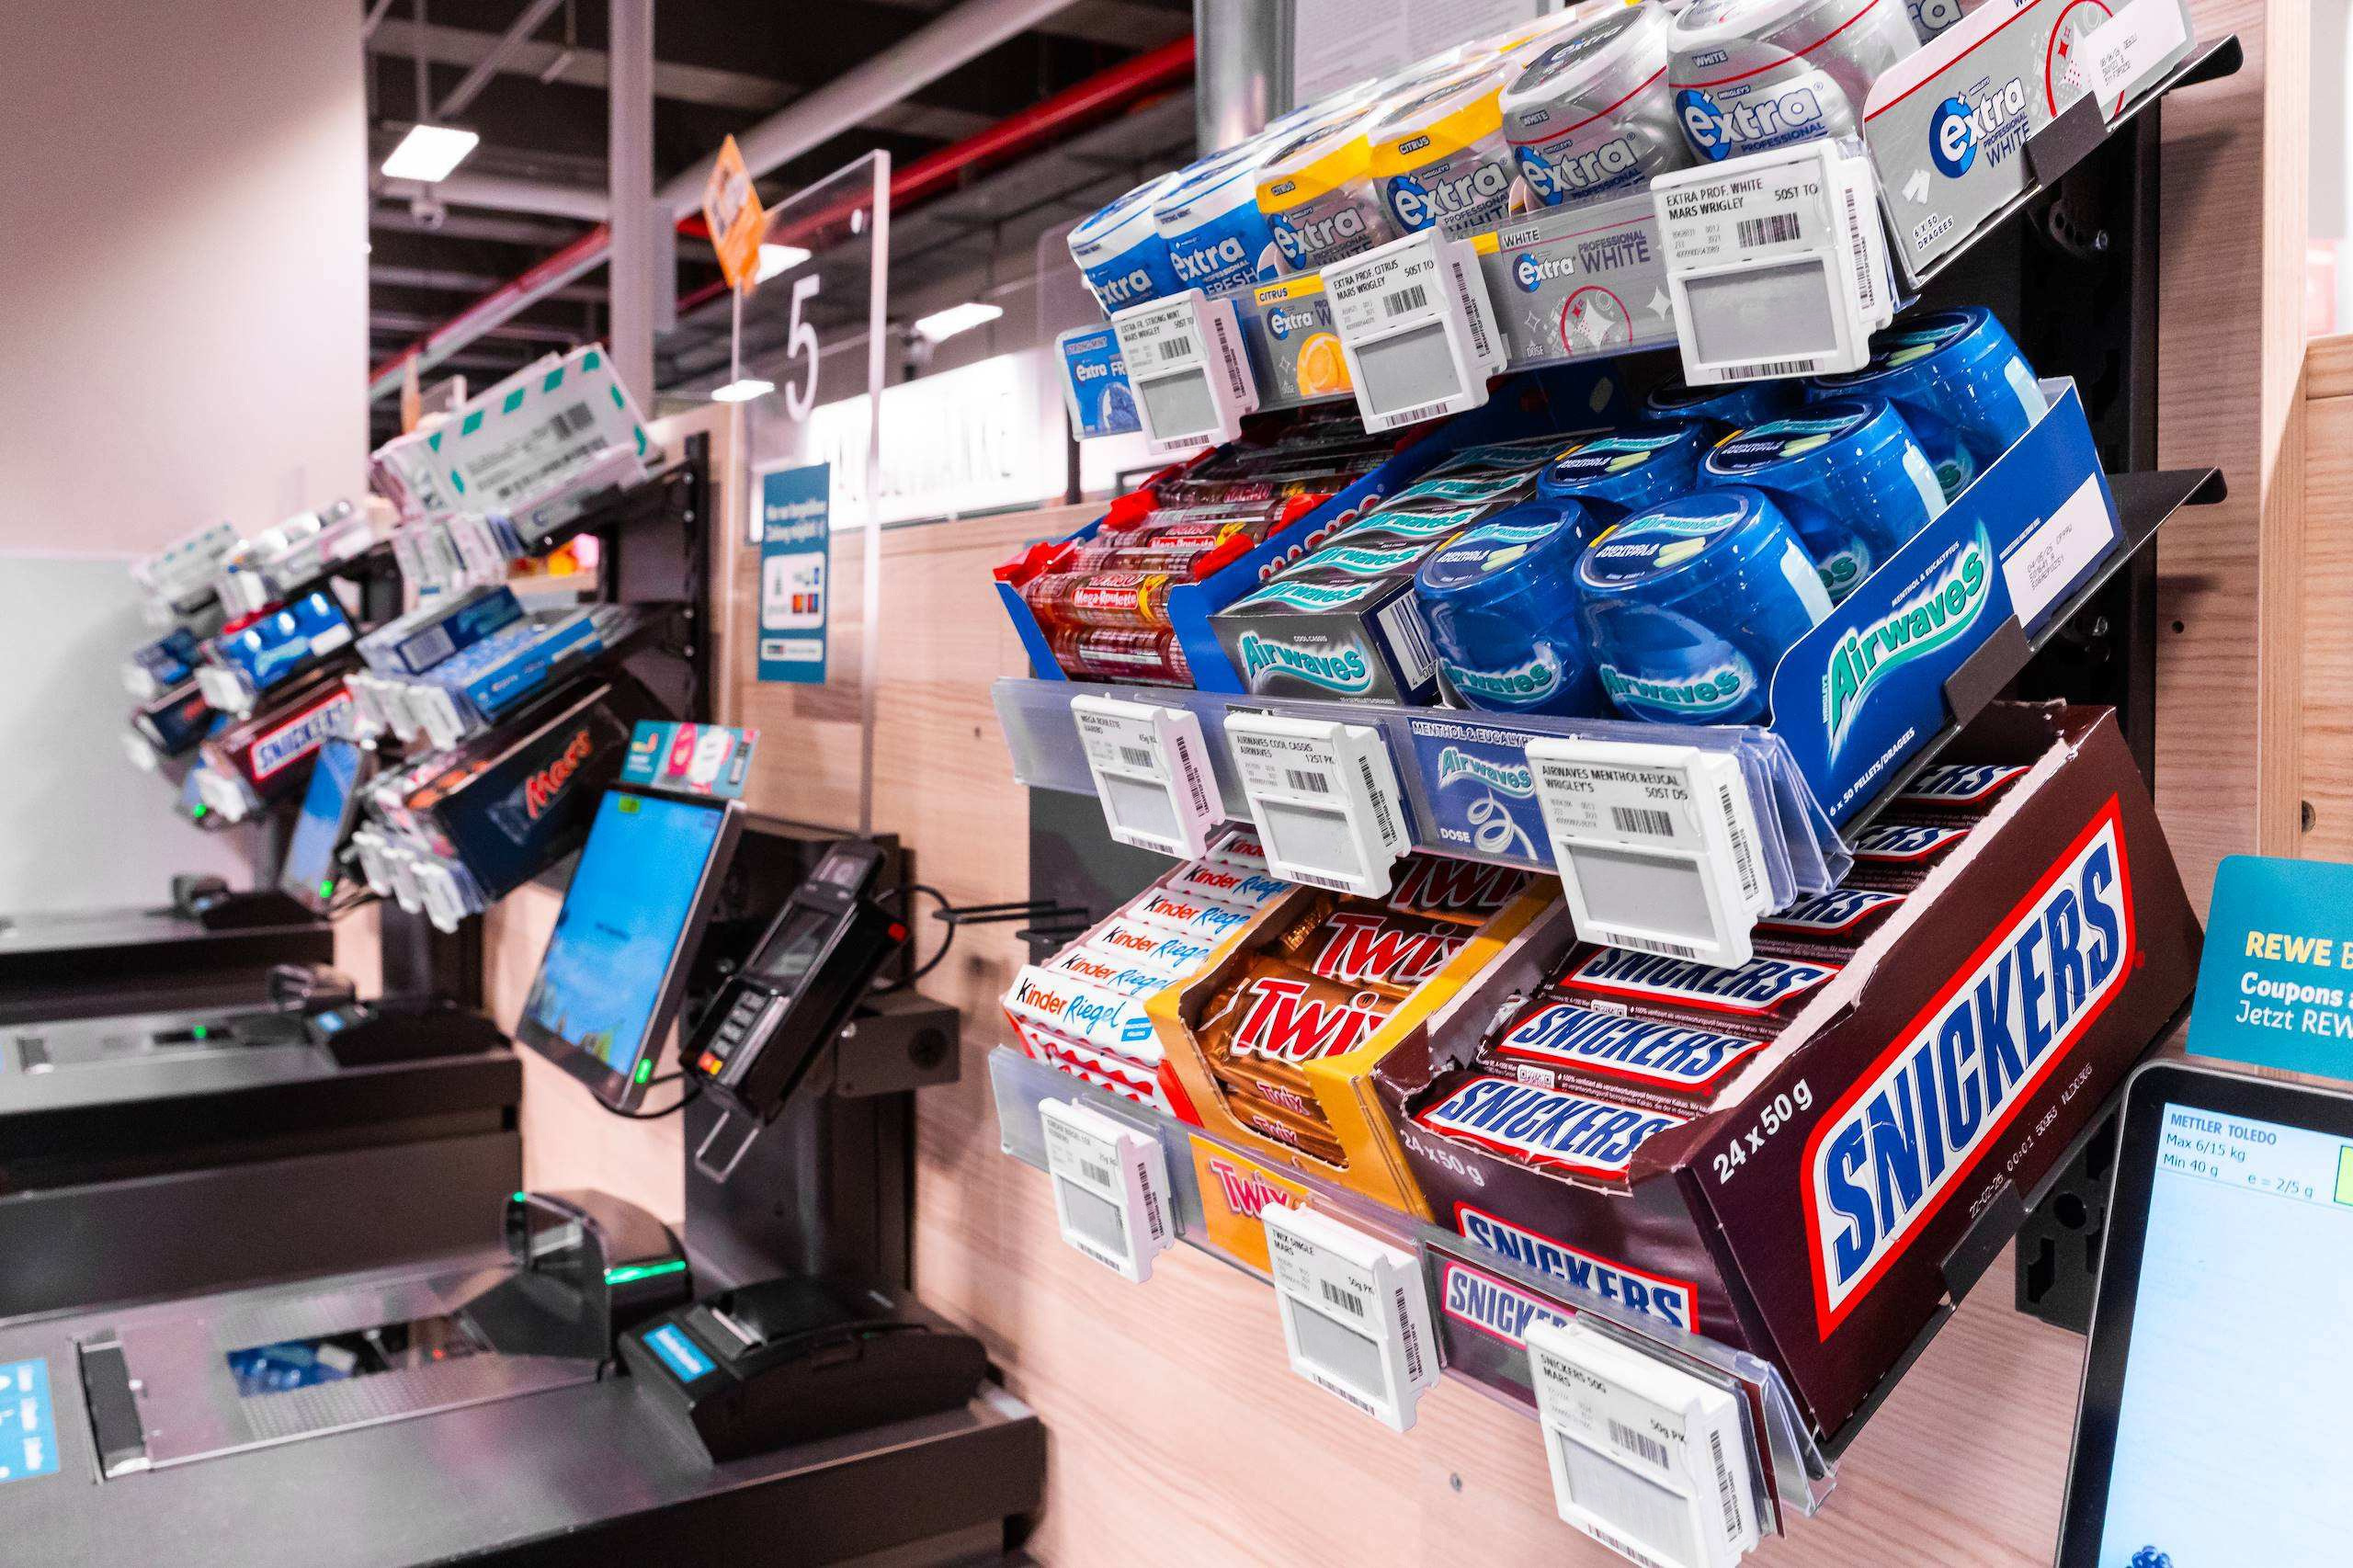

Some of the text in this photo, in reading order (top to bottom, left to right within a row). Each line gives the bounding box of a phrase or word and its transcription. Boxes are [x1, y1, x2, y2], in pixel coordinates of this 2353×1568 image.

[1692, 50, 1728, 68] WHITE
[1520, 109, 1549, 127] WHITE
[1685, 87, 1824, 148] extra
[1939, 77, 2027, 162] extra
[1983, 113, 2028, 149] PROFESSIONAL
[1399, 136, 1430, 154] CITRUS
[1740, 121, 1828, 153] PROFESSIONAL
[1985, 122, 2031, 168] WHITE
[1525, 138, 1639, 198] extra
[1271, 181, 1295, 197] CITRUS
[1393, 162, 1509, 228] extra
[1444, 190, 1507, 223] PROFESSIONA
[1666, 178, 1763, 208] EXTRA PROF. WHITE
[1668, 198, 1745, 221] MARS WRIGLEY
[1274, 207, 1367, 260] extra
[1504, 231, 1540, 248] WHITE
[1579, 229, 1646, 254] PROFESSIONAL
[1170, 236, 1245, 282] extra
[1334, 276, 1356, 290] EXTRA
[1374, 260, 1399, 277] CITRUS
[1518, 256, 1575, 285] extra
[1579, 240, 1651, 275] WHITE
[1258, 287, 1289, 302] CITRUS
[1336, 277, 1386, 301] MARS WRIGLEY
[1271, 309, 1313, 335] extra
[784, 274, 821, 424] 5
[1892, 582, 1920, 608] MENTHOL
[1925, 540, 1960, 579] EUCALYPTUS
[1243, 633, 1370, 683] Airwaves
[1831, 551, 1984, 733] Airwaves
[1599, 664, 1742, 705] Airwaves
[1236, 735, 1269, 747] AIRWAVES
[1240, 746, 1273, 758] AIRWAVES
[526, 730, 593, 820] Mars
[1441, 749, 1531, 789] Airwaves
[1542, 765, 1589, 780] AIRWAVES
[1545, 778, 1595, 794] WRIGLEY'S
[1829, 805, 1836, 816] 6
[1843, 788, 1855, 804] 50
[1854, 727, 1916, 793] PELLETS/DRAGEES
[1440, 827, 1471, 844] DOSE
[1182, 864, 1243, 890] Kinder
[1142, 894, 1251, 936] Kinder Riege
[1102, 925, 1211, 968] Kinder Riege
[2245, 930, 2334, 967] REWE
[1061, 953, 1115, 983] Kinder
[1016, 976, 1067, 1017] Kinder
[1064, 994, 1127, 1036] Riegel
[2240, 971, 2345, 1007] Coupons
[2235, 1000, 2353, 1040] Jetzt REW
[1512, 1006, 1745, 1077] SNICKERS
[1826, 841, 2120, 1287] SNICKERS
[1435, 1081, 1675, 1164] SNICKERS
[1713, 1077, 1813, 1185] 24 x 50 g
[2170, 1112, 2278, 1146] METTLER TOLEDO
[1400, 1129, 1425, 1156] 24
[1437, 1148, 1466, 1175] 50
[1466, 1165, 1485, 1187] g
[2163, 1153, 2219, 1179] Min 40 g
[2166, 1132, 2246, 1164] Max 6/15 kg
[2275, 1175, 2302, 1196] 2/5
[2303, 1185, 2314, 1199] g
[1465, 1214, 1684, 1329] SNICKERS
[1449, 1270, 1568, 1339] SNICK
[1543, 1368, 1571, 1388] MARS
